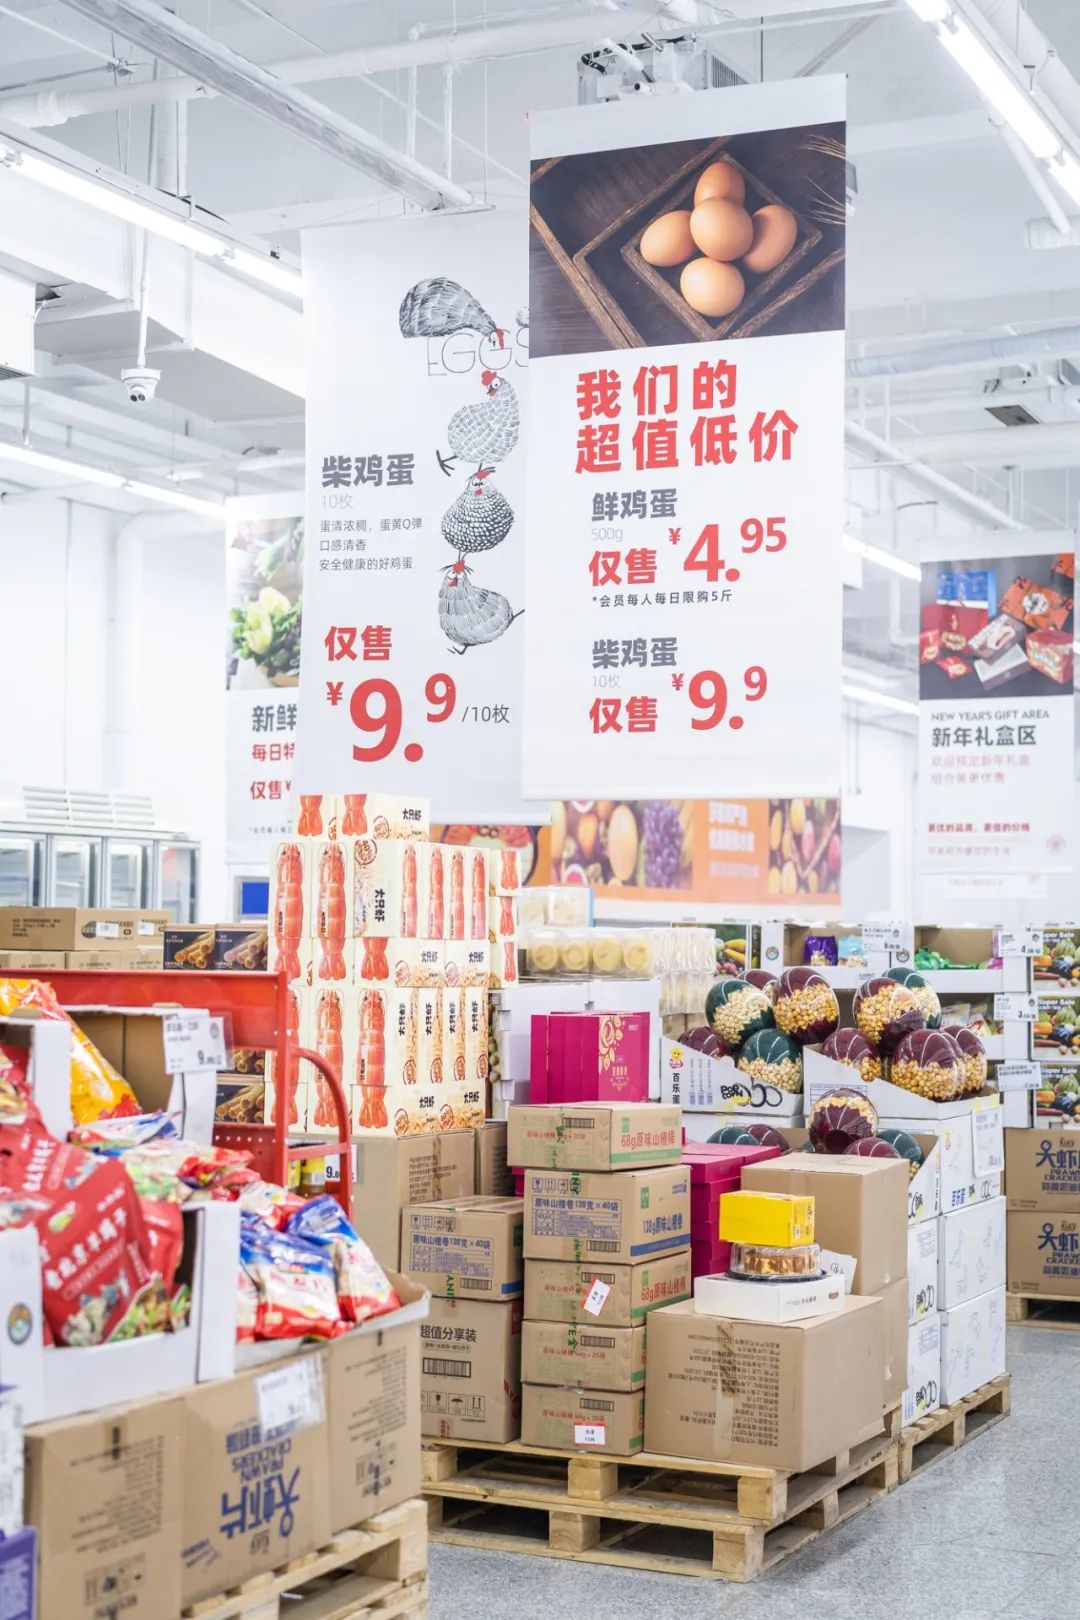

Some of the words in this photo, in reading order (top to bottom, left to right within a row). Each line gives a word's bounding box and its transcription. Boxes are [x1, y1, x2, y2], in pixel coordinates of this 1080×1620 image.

[576, 359, 737, 421] 我们的
[575, 410, 799, 474] 超值低价
[322, 453, 415, 489] 柴鸡蛋
[322, 494, 353, 510] 10枚
[592, 488, 678, 522] 鲜鸡蛋
[320, 538, 367, 552] 口感清香
[591, 526, 623, 542] 500g
[319, 556, 414, 571] 安全健康的好鸡蛋
[589, 547, 658, 587] 仅售
[324, 625, 393, 663] 仅售
[592, 636, 678, 670] 柴鸡蛋
[592, 674, 621, 689] 10枚
[252, 703, 298, 732] 新鲜
[589, 695, 658, 734] 仅售
[931, 711, 956, 721] NEW
[959, 710, 992, 721] YEAR'S
[994, 710, 1018, 720] GIFT
[1021, 709, 1050, 719] AREA
[932, 725, 1037, 747] 新年礼盒区
[250, 780, 282, 801] 仅售
[374, 889, 385, 922] 大只虾
[1035, 1140, 1080, 1168] 大虾
[421, 1325, 477, 1343] 超值分享装
[219, 1466, 300, 1539] 大虾片
